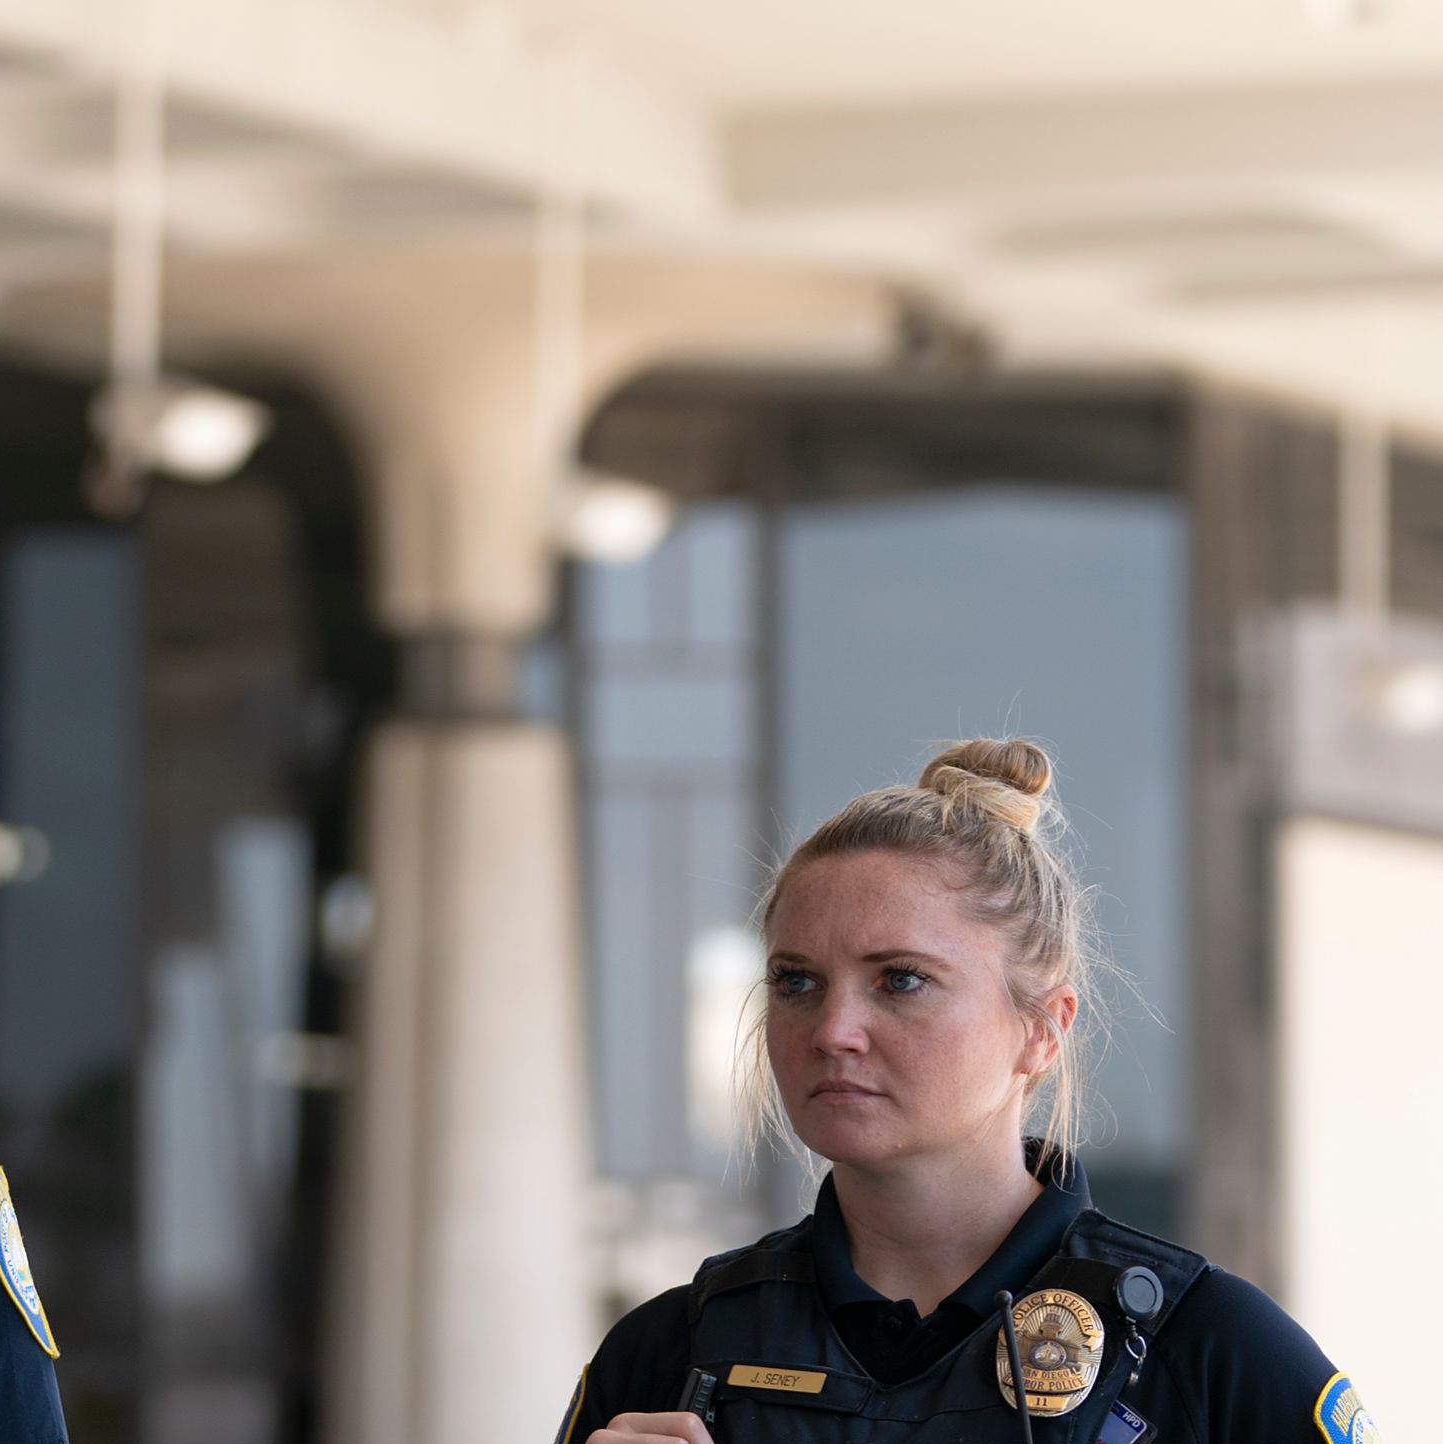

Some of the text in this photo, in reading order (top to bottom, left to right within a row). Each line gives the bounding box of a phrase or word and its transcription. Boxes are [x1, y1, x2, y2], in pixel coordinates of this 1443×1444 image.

[1053, 1292, 1095, 1332] OFFICER
[750, 1372, 801, 1387] J. SENEY
[1041, 1370, 1069, 1379] DIEGO
[1049, 1376, 1085, 1391] POLICE
[1035, 1397, 1047, 1406] 11
[1122, 1411, 1141, 1428] HPD
